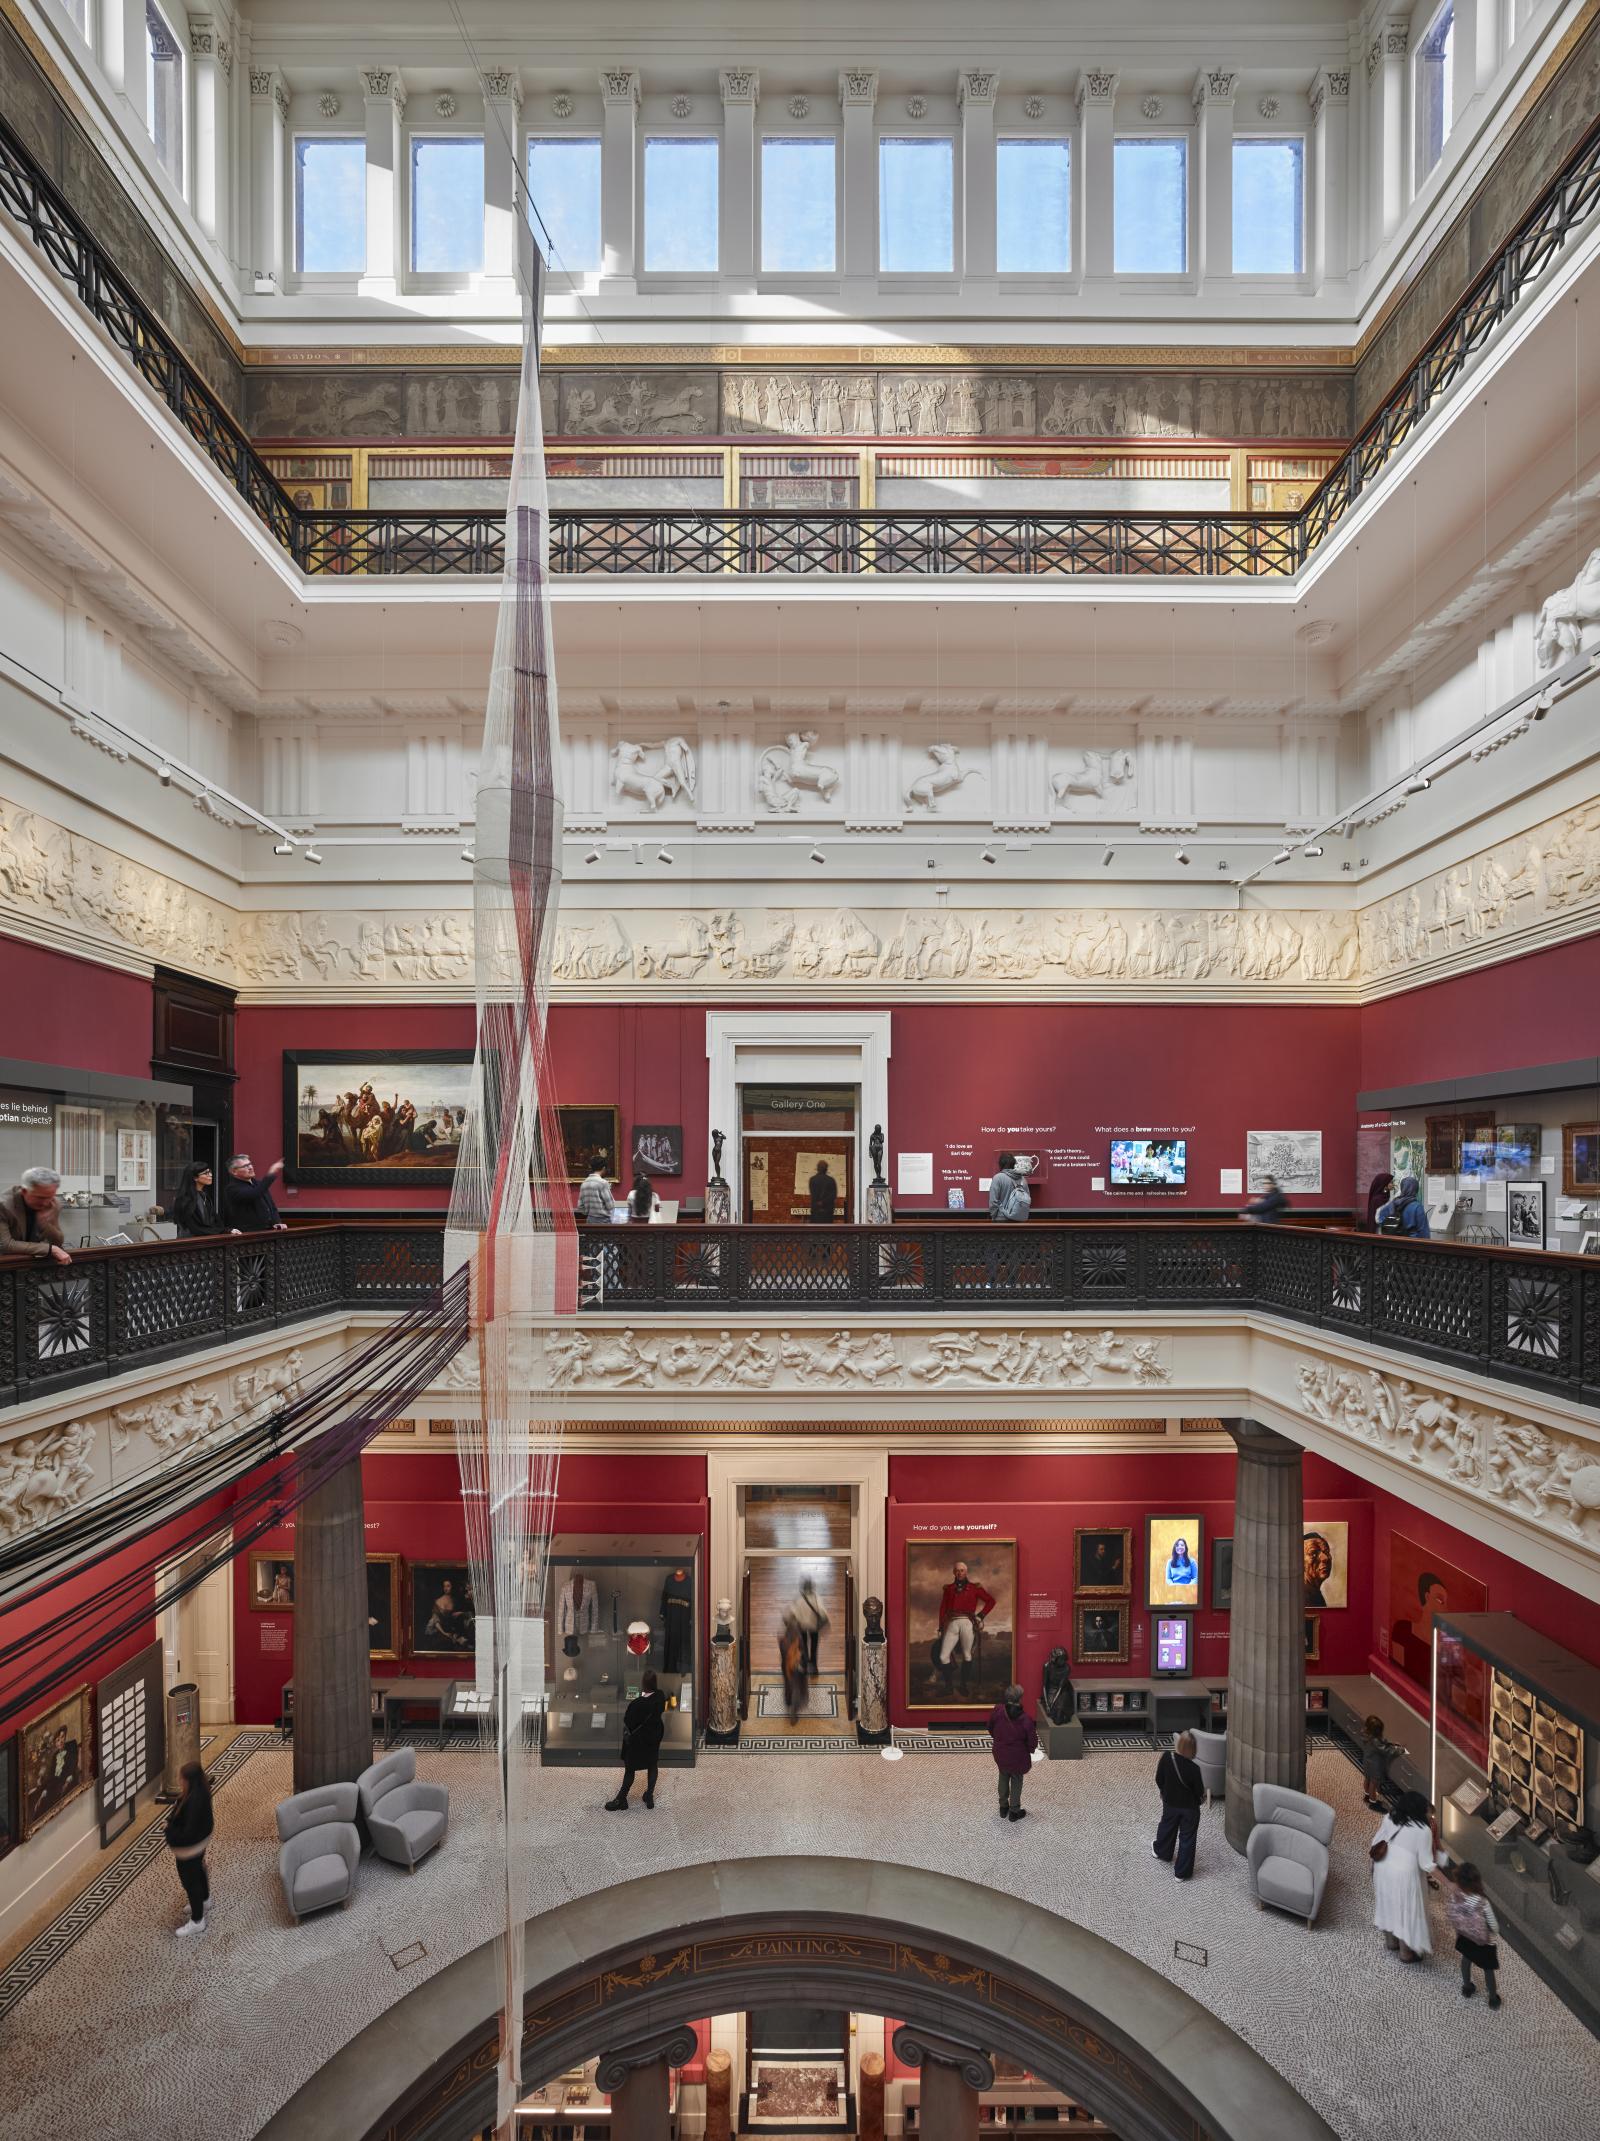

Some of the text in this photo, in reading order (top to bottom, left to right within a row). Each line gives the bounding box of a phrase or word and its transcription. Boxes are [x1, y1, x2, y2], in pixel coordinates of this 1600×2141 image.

[11, 1102, 21, 1111] lie
[22, 1103, 48, 1114] behind
[771, 1100, 826, 1109] Gallery One
[21, 1115, 53, 1125] objects?
[1035, 1126, 1056, 1134] yours?
[1181, 1126, 1196, 1134] you?
[966, 1523, 998, 1531] yourself?
[755, 1940, 835, 1955] PAINTING
